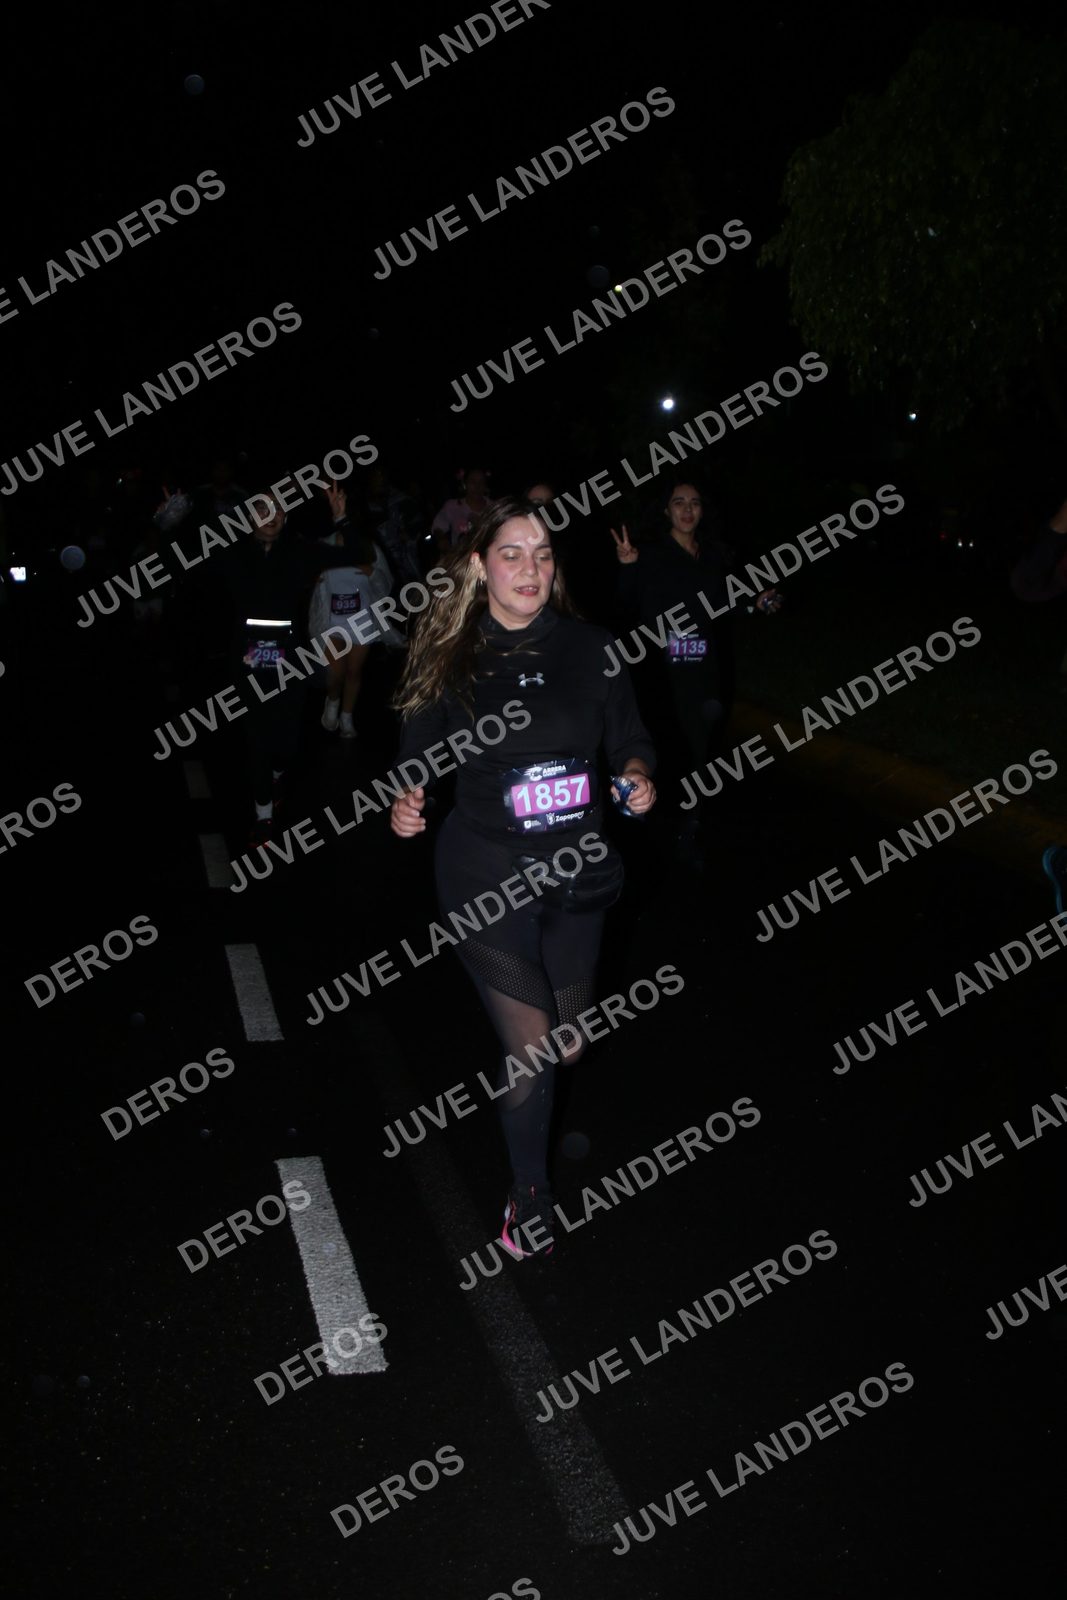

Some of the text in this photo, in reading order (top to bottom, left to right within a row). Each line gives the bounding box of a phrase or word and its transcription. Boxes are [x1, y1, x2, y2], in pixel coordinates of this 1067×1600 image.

[253, 648, 281, 663] 298
[673, 639, 706, 656] 1135
[517, 775, 586, 813] 1857
